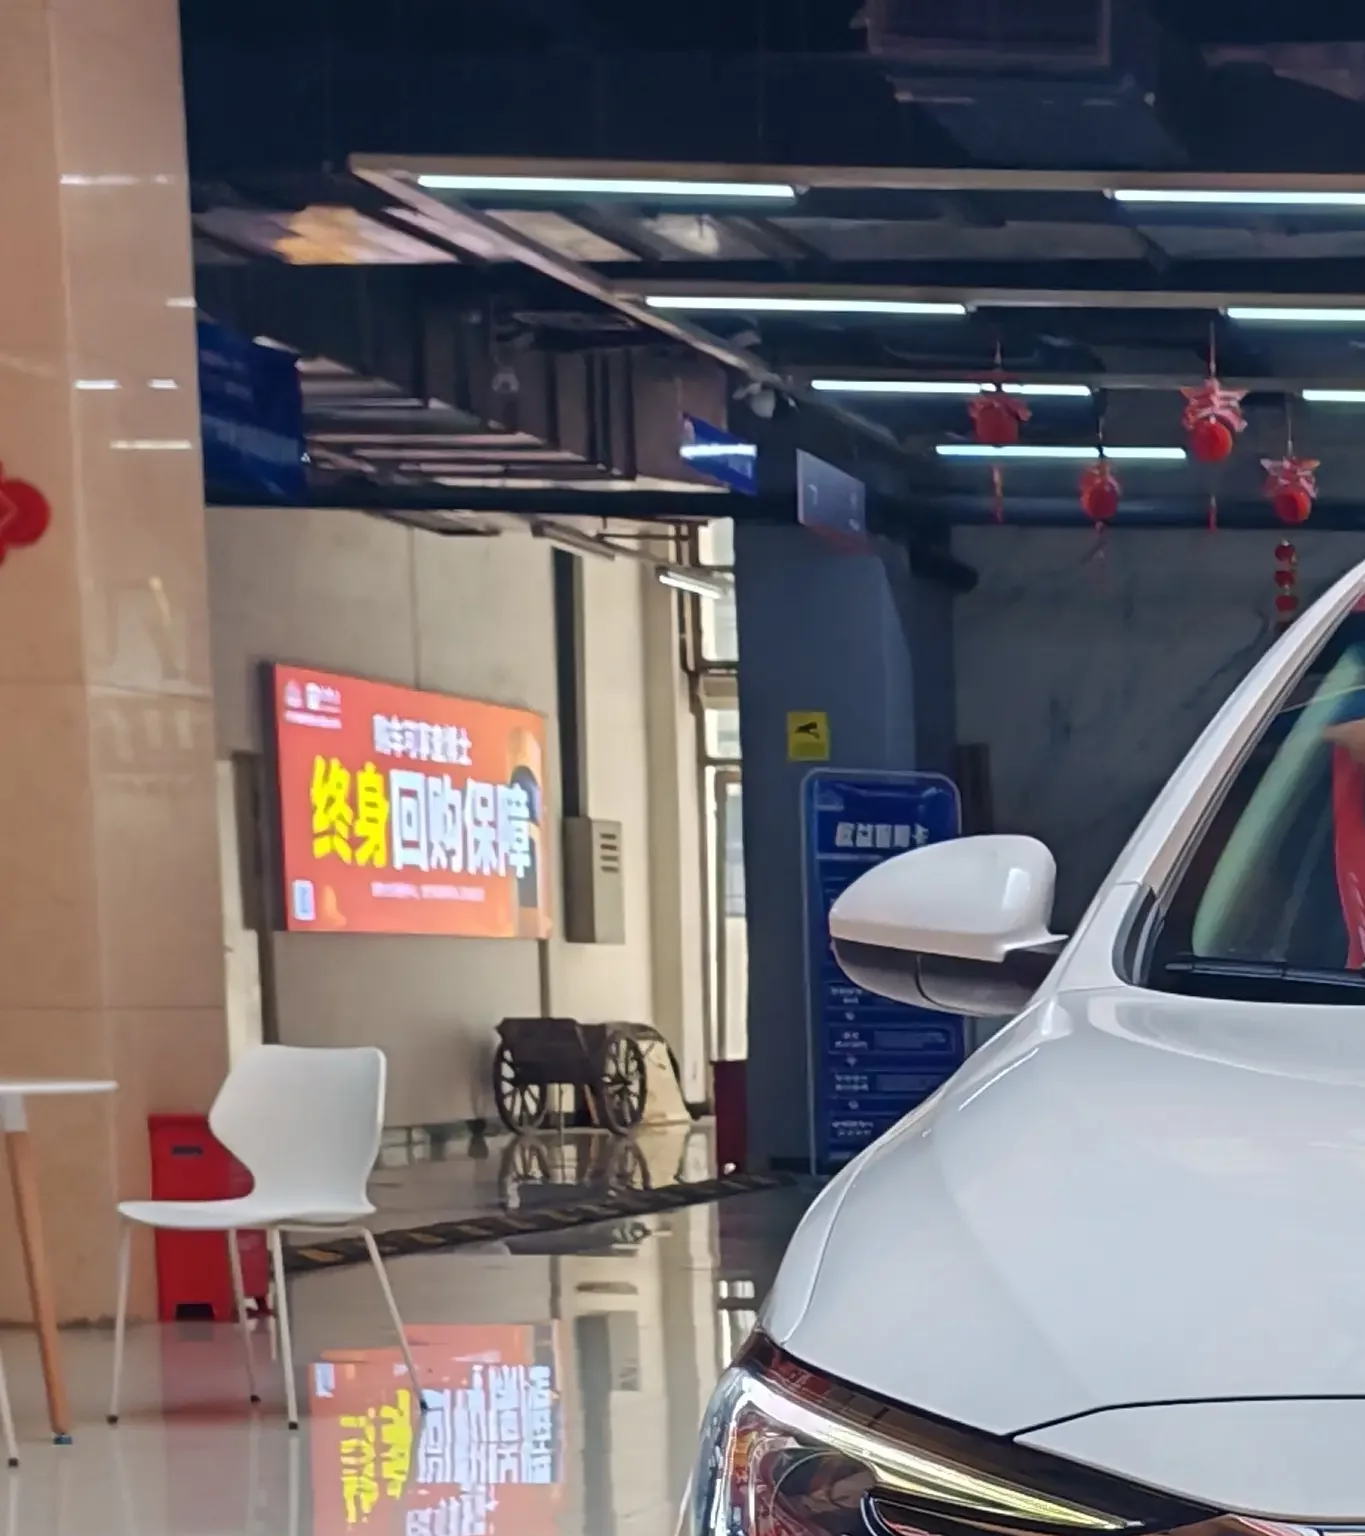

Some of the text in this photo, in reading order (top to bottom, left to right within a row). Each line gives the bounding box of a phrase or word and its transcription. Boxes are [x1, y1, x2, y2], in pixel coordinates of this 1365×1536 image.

[310, 755, 531, 878] 终身回购保障
